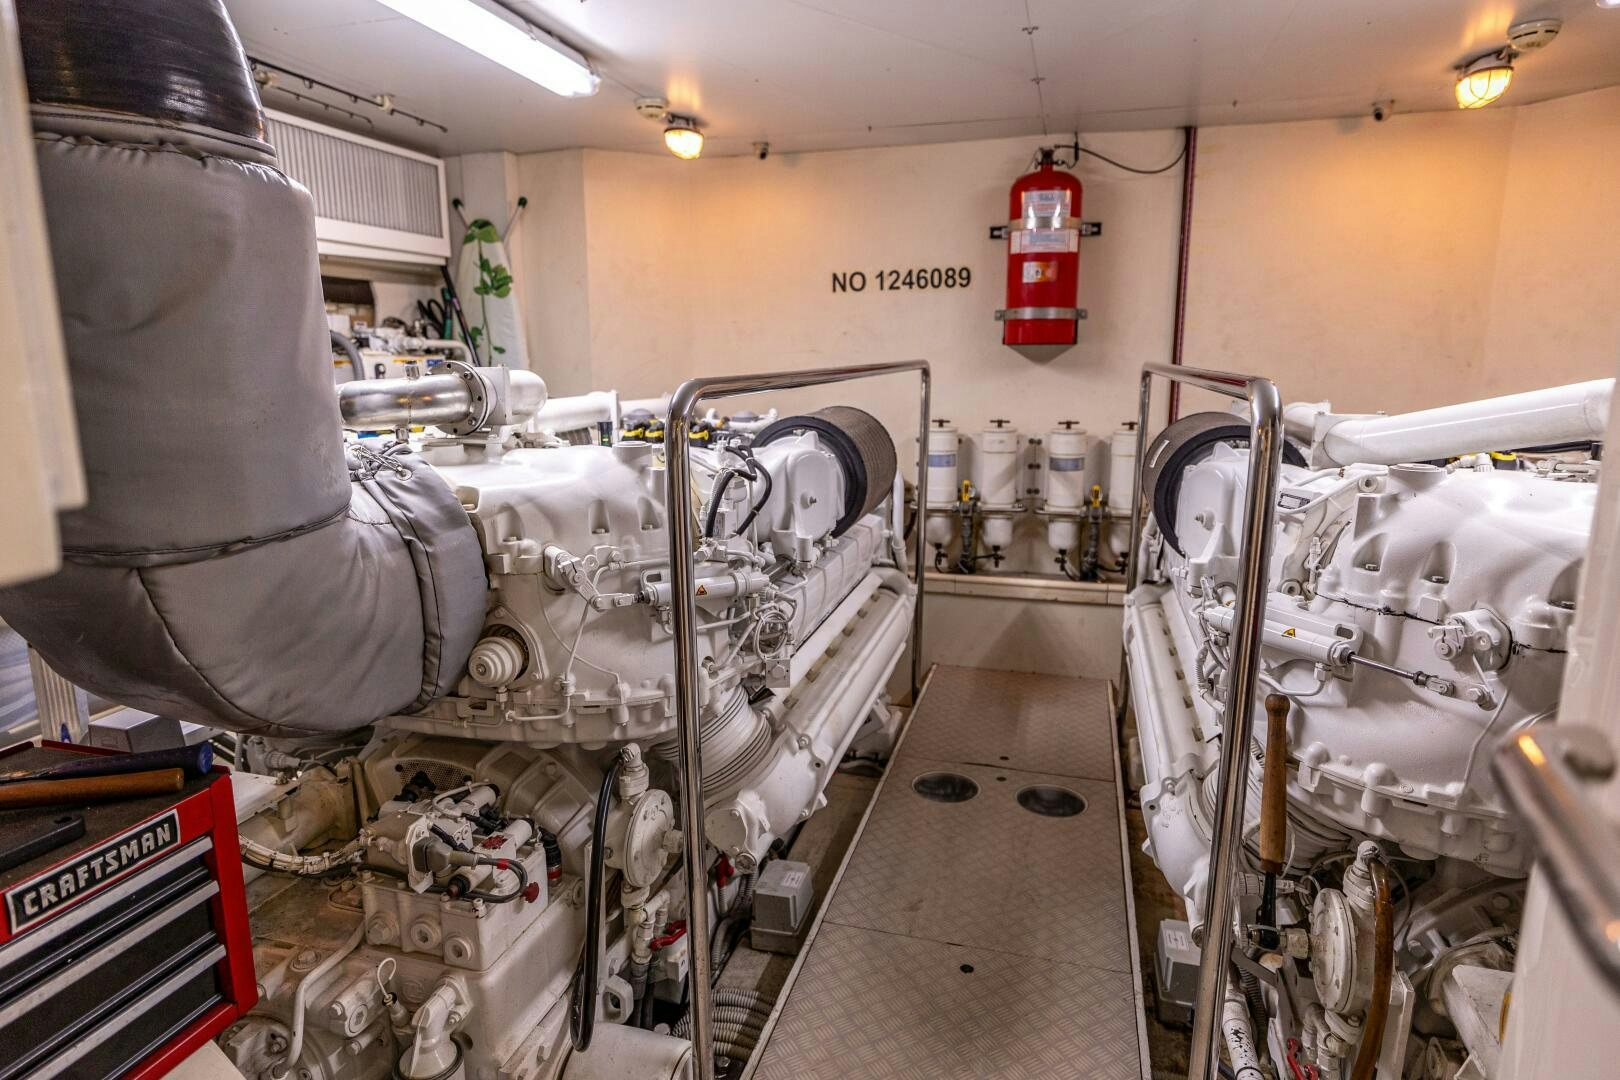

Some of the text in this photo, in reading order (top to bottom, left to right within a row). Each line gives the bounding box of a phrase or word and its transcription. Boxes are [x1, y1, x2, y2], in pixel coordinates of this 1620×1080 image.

[832, 266, 972, 293] NO 1246089
[23, 823, 172, 916] CRAFTSMAN
